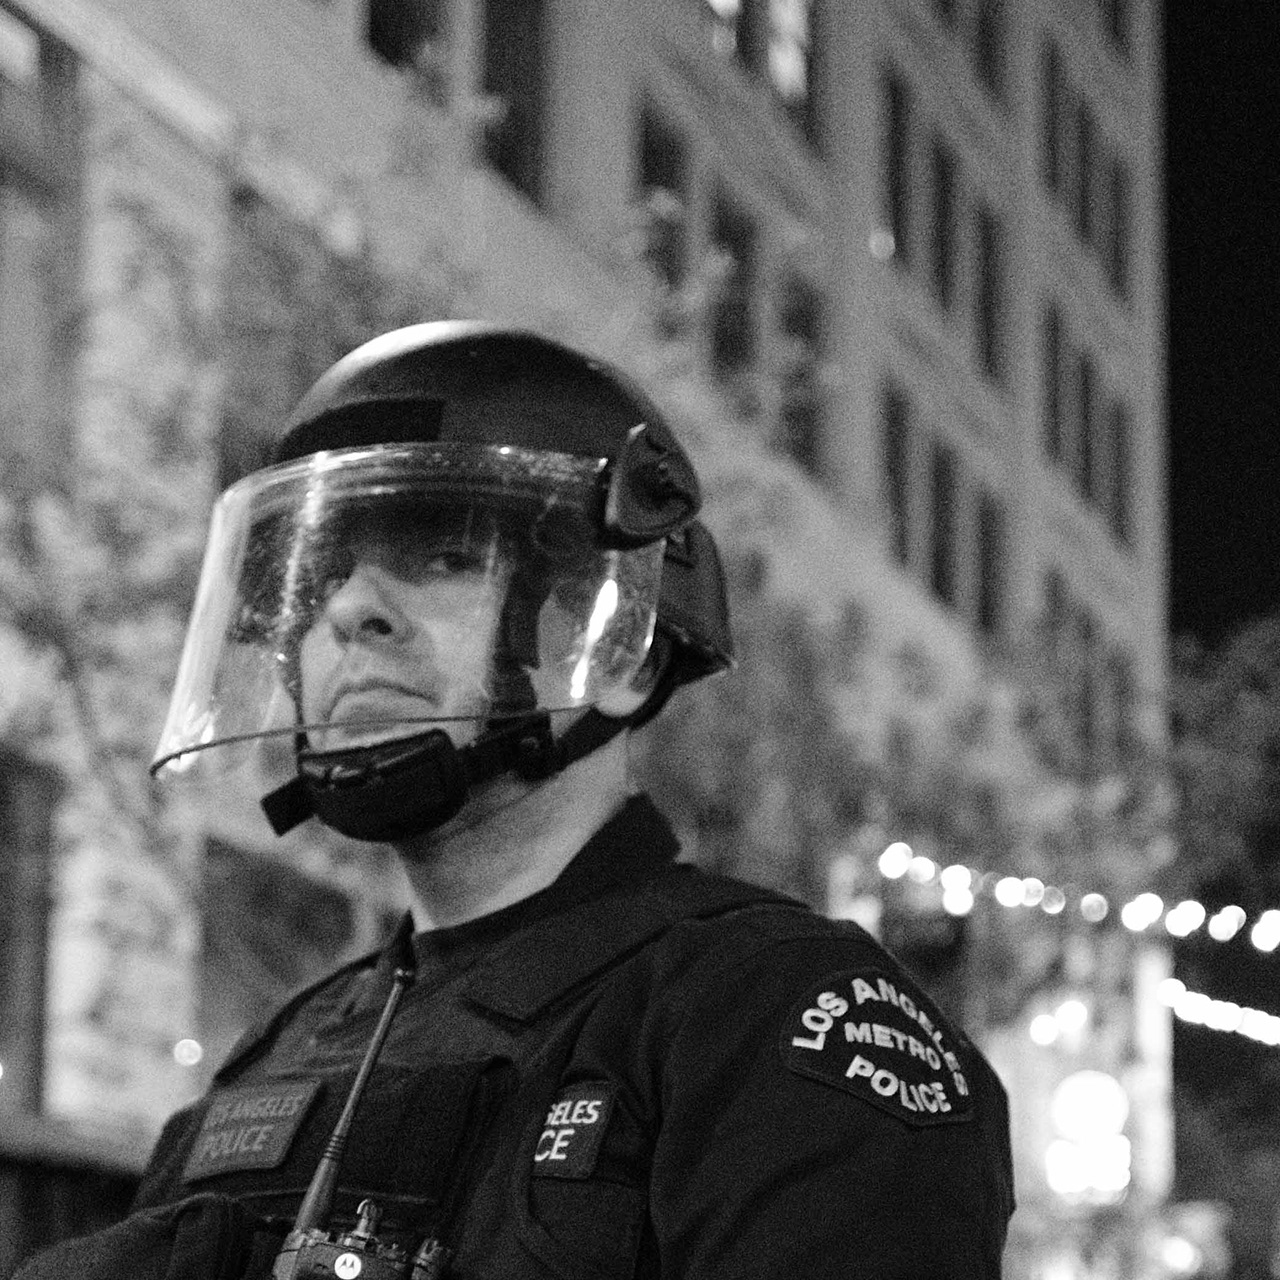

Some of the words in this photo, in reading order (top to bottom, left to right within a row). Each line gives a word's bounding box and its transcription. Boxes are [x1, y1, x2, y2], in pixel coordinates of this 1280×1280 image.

[792, 991, 849, 1051] LOS
[851, 977, 969, 1096] ANGELES
[844, 1021, 941, 1070] METRO
[845, 1054, 952, 1113] POLICE
[198, 1124, 275, 1160] POLICE
